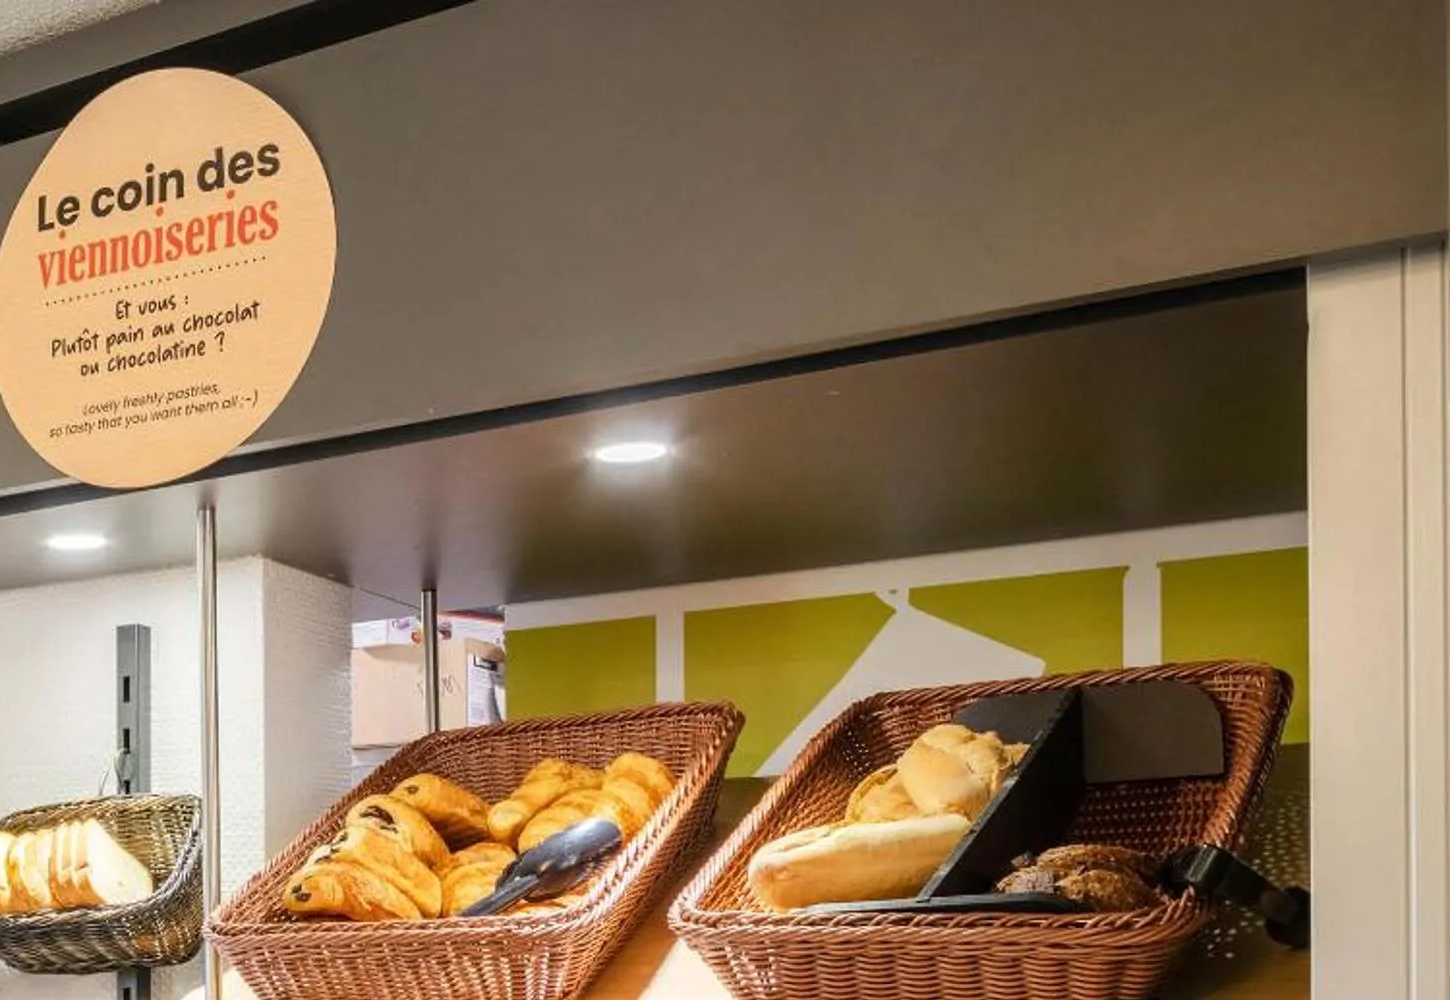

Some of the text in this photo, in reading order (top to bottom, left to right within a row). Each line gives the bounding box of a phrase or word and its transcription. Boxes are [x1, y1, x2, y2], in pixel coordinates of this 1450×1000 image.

[38, 143, 280, 232] Le coin des
[37, 189, 280, 290] viennoiseries
[51, 301, 260, 358] Plutôt pain au chocolat
[115, 300, 131, 320] Et
[138, 295, 177, 315] vous
[80, 331, 226, 377] ou chocolatine ?
[50, 426, 63, 439] so
[65, 420, 97, 438] tasty
[98, 416, 123, 431] that
[125, 412, 149, 430] you
[150, 407, 183, 423] want
[184, 402, 220, 417] them
[123, 391, 164, 411] freshly
